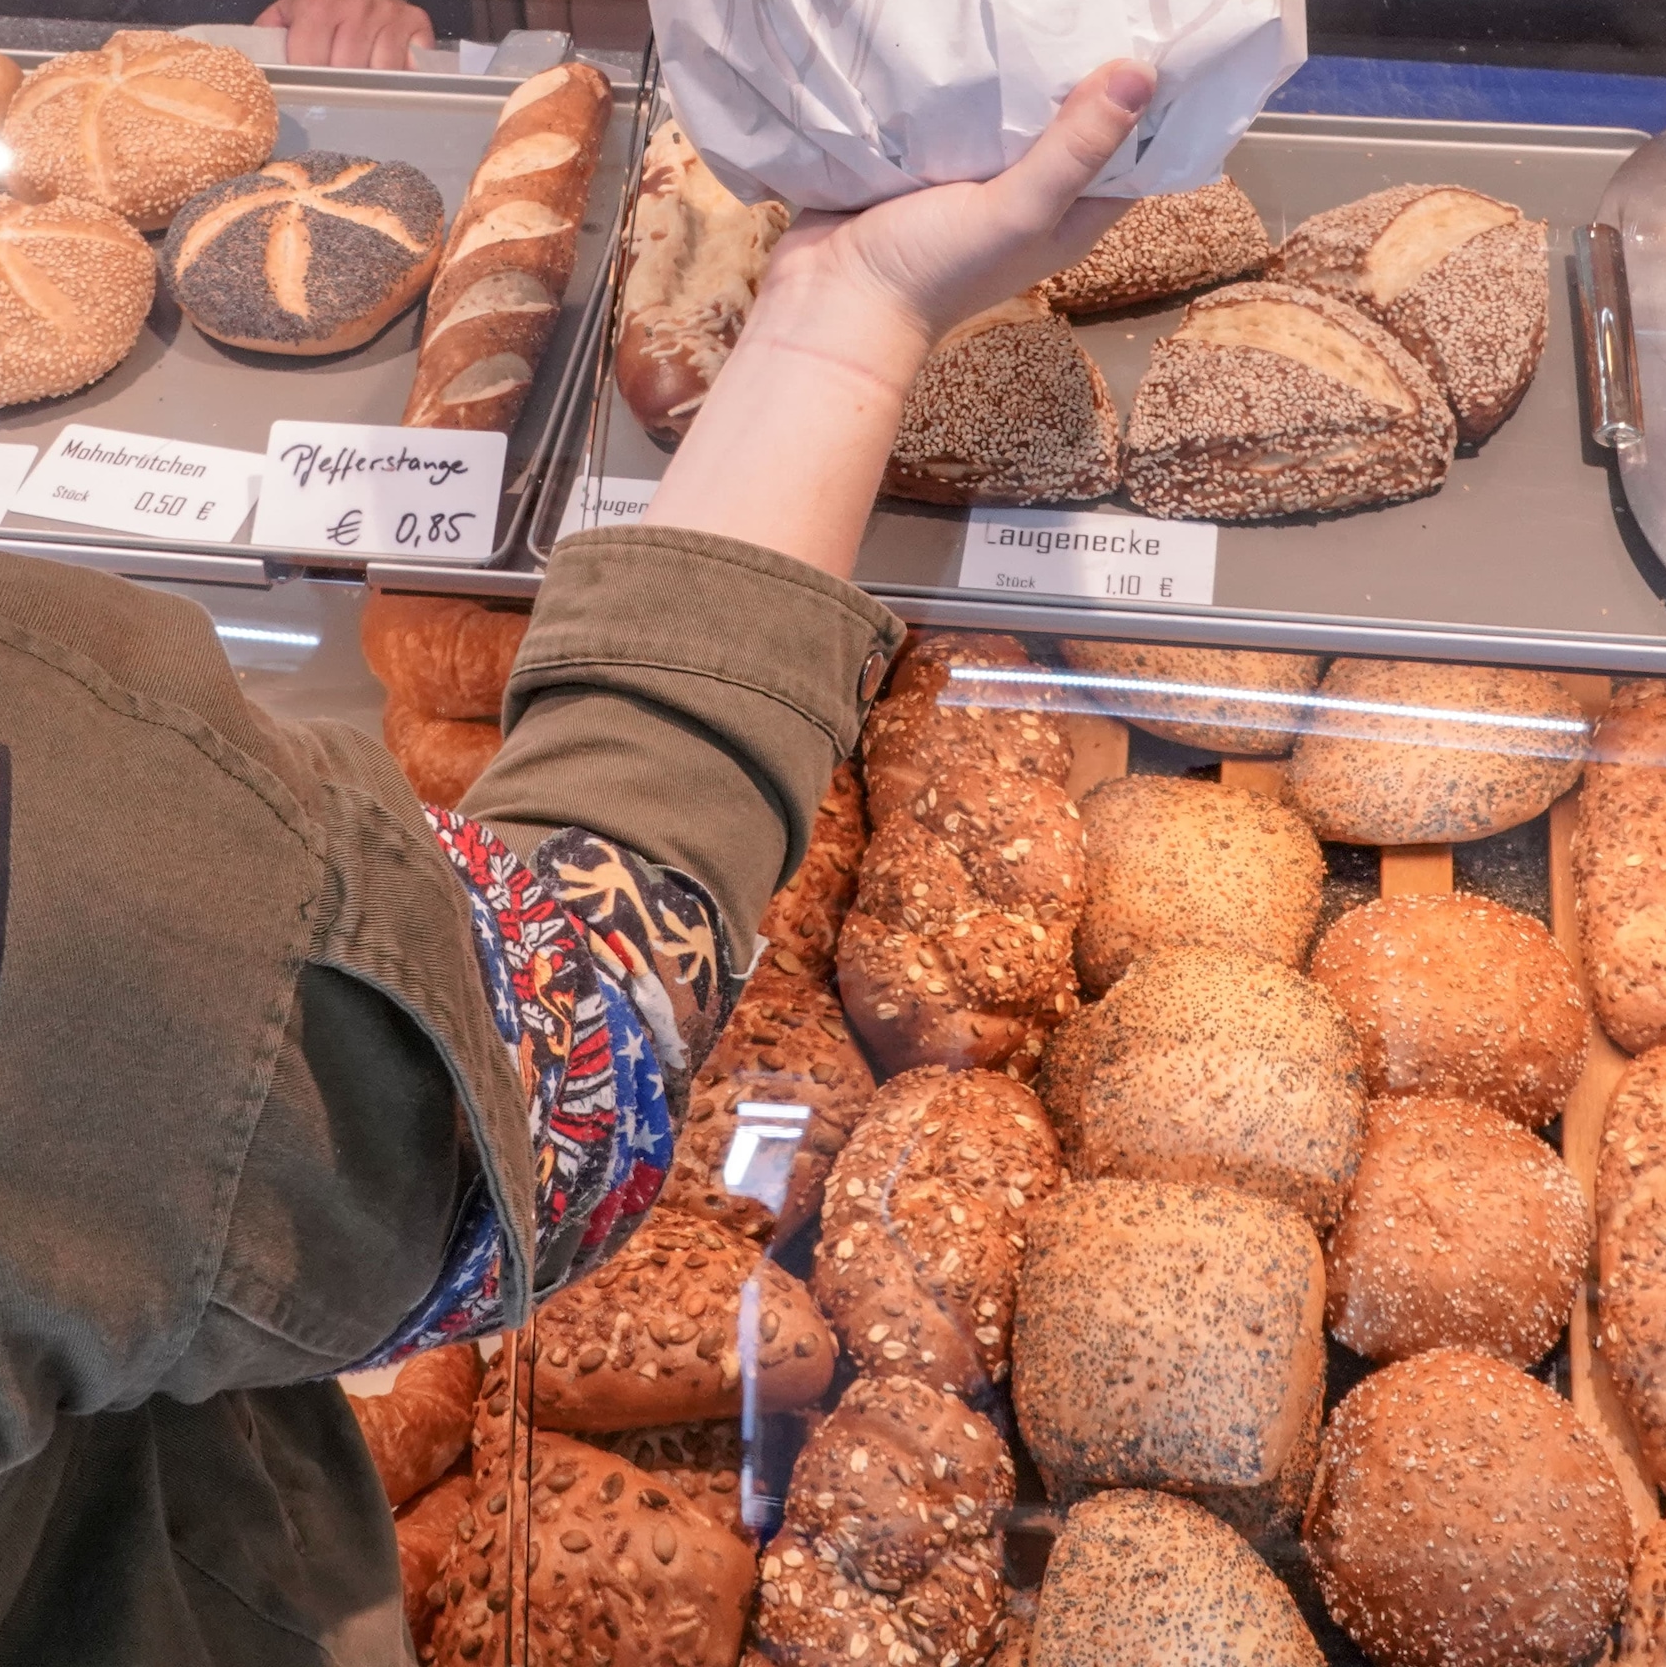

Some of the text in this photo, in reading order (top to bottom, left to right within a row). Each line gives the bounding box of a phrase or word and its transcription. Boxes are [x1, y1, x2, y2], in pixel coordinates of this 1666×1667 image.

[61, 438, 207, 478] Mohnbrötchen
[281, 444, 468, 487] Pfefferstange
[52, 485, 90, 503] Stück
[196, 501, 216, 521] €
[327, 509, 476, 548] € 0,85
[985, 519, 1161, 556] Laugenecke
[995, 573, 1174, 598] Stück 1.10 €
